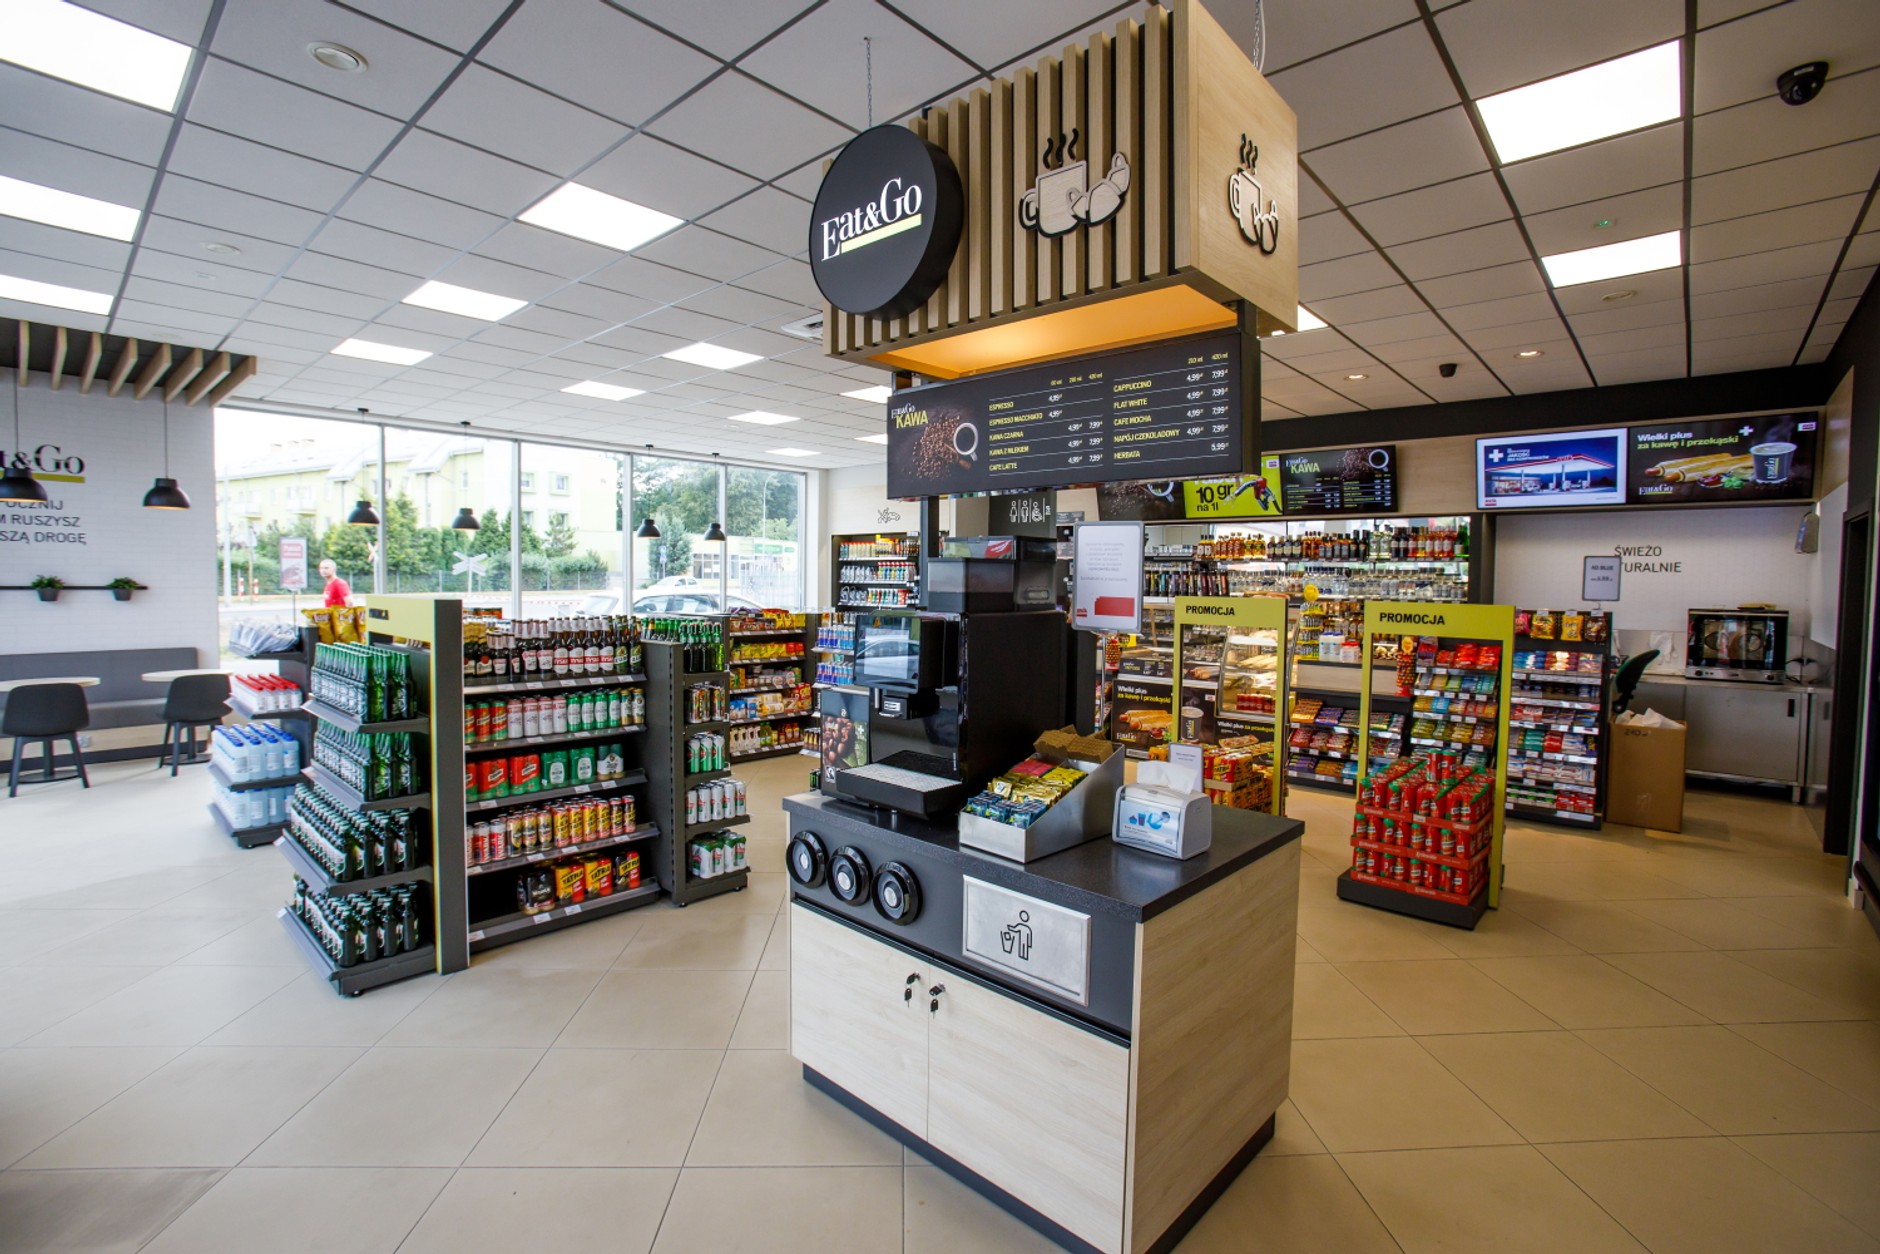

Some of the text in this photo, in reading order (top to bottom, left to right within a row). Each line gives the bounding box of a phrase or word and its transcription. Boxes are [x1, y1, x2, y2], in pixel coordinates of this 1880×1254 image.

[821, 177, 922, 261] Eat&Go
[1113, 380, 1152, 392] CAPPUCCINO
[989, 402, 1014, 411] ESPRESSO
[1113, 400, 1129, 409] FLAT
[1129, 398, 1148, 408] WHITE
[896, 410, 928, 429] KAWA
[989, 416, 1014, 426] ESPRESSO
[1129, 415, 1152, 424] MOCHA
[989, 433, 1003, 441] KAWA
[1004, 430, 1024, 439] CZARNA
[1113, 432, 1134, 443] NAPÓJ
[1135, 428, 1180, 440] CZEKOLADOWY
[1637, 431, 1693, 442] Wielki plus
[1651, 440, 1679, 449] kawę
[1687, 436, 1739, 447] przekąski
[989, 448, 1003, 456] KAWA
[1008, 446, 1029, 454] MLEKIEM
[1114, 450, 1140, 459] HERBATA
[1002, 462, 1018, 470] LATTE
[1290, 463, 1320, 474] KAWA
[1196, 484, 1234, 503] 10 gr
[11, 514, 80, 527] RUSZYSZ
[35, 532, 87, 545] DROGĘ
[1186, 605, 1235, 616] PROMOCJA
[1380, 612, 1445, 625] PROMOCJA
[562, 870, 583, 885] TATRA
[591, 865, 610, 879] TATRA
